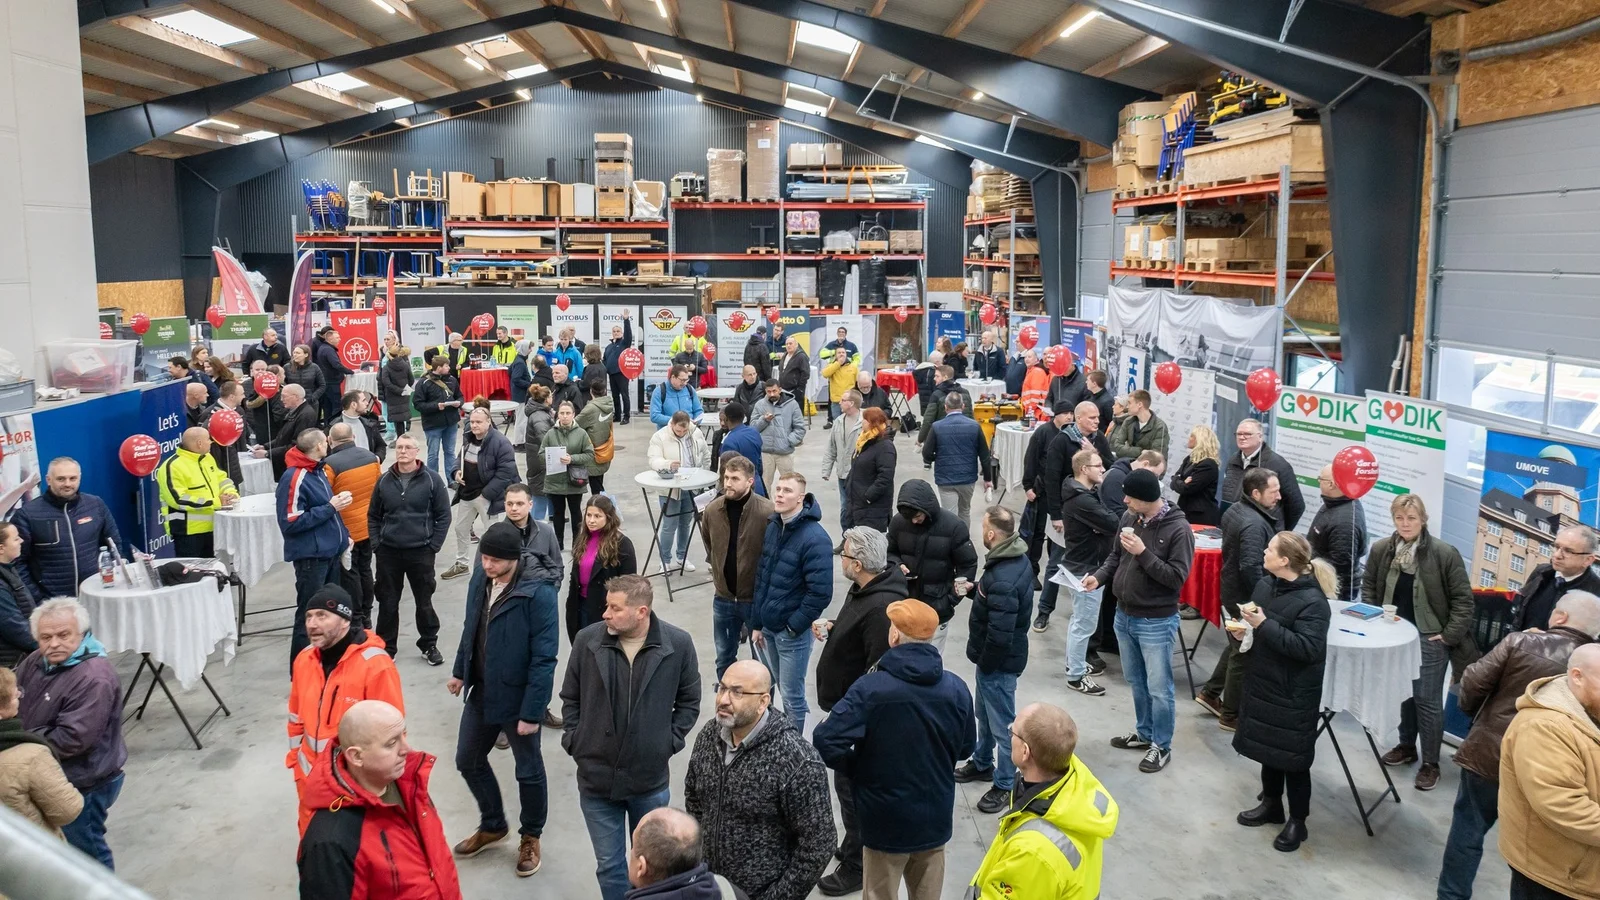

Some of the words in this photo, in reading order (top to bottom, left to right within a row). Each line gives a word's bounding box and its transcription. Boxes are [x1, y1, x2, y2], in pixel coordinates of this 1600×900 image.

[349, 317, 371, 325] FALCK
[158, 412, 179, 431] Let's
[1515, 461, 1550, 475] UMOVE
